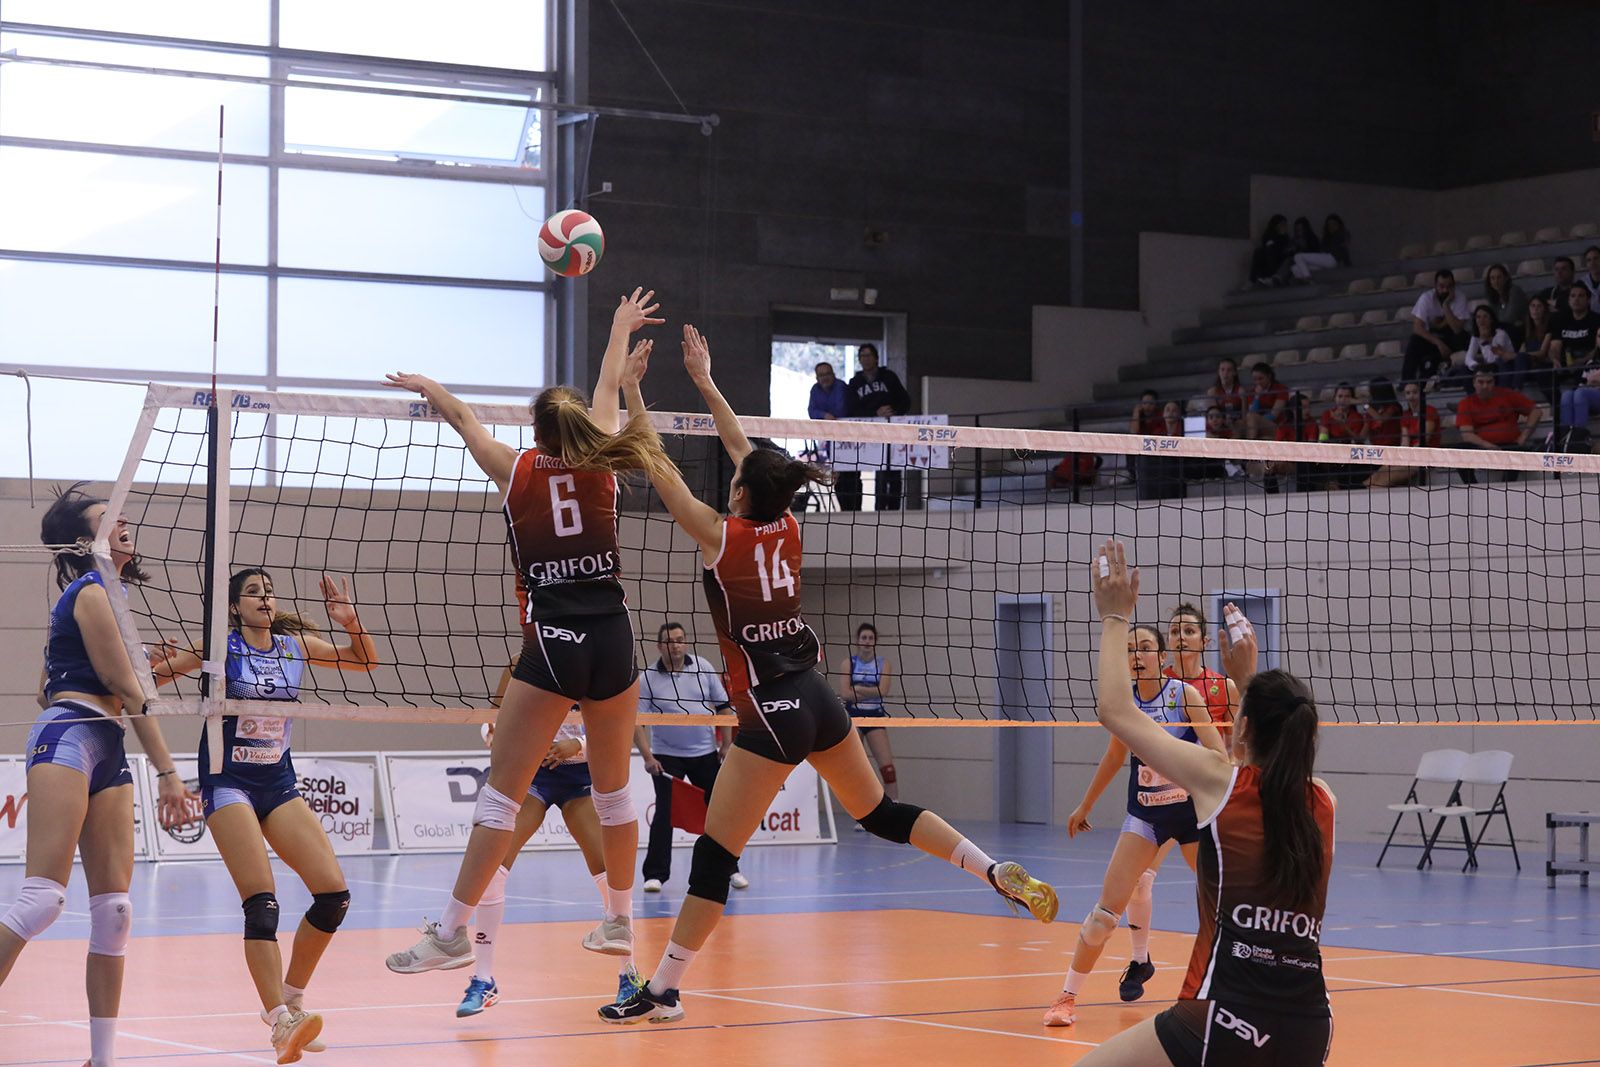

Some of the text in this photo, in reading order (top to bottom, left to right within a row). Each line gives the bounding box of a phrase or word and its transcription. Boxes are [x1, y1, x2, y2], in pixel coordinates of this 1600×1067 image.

[936, 429, 958, 439] SFV
[1160, 440, 1179, 449] SFV
[1556, 456, 1573, 464] SFV
[548, 473, 583, 537] 6
[754, 518, 788, 536] PAULA
[529, 551, 613, 580] GRIFOLS
[754, 538, 795, 602] 14
[542, 625, 587, 644] DSV
[263, 678, 276, 695] 5
[761, 699, 800, 713] DSV
[298, 775, 346, 795] scola
[320, 814, 371, 841] Cugat
[413, 824, 455, 837] Global
[1215, 1007, 1271, 1048] DSV
